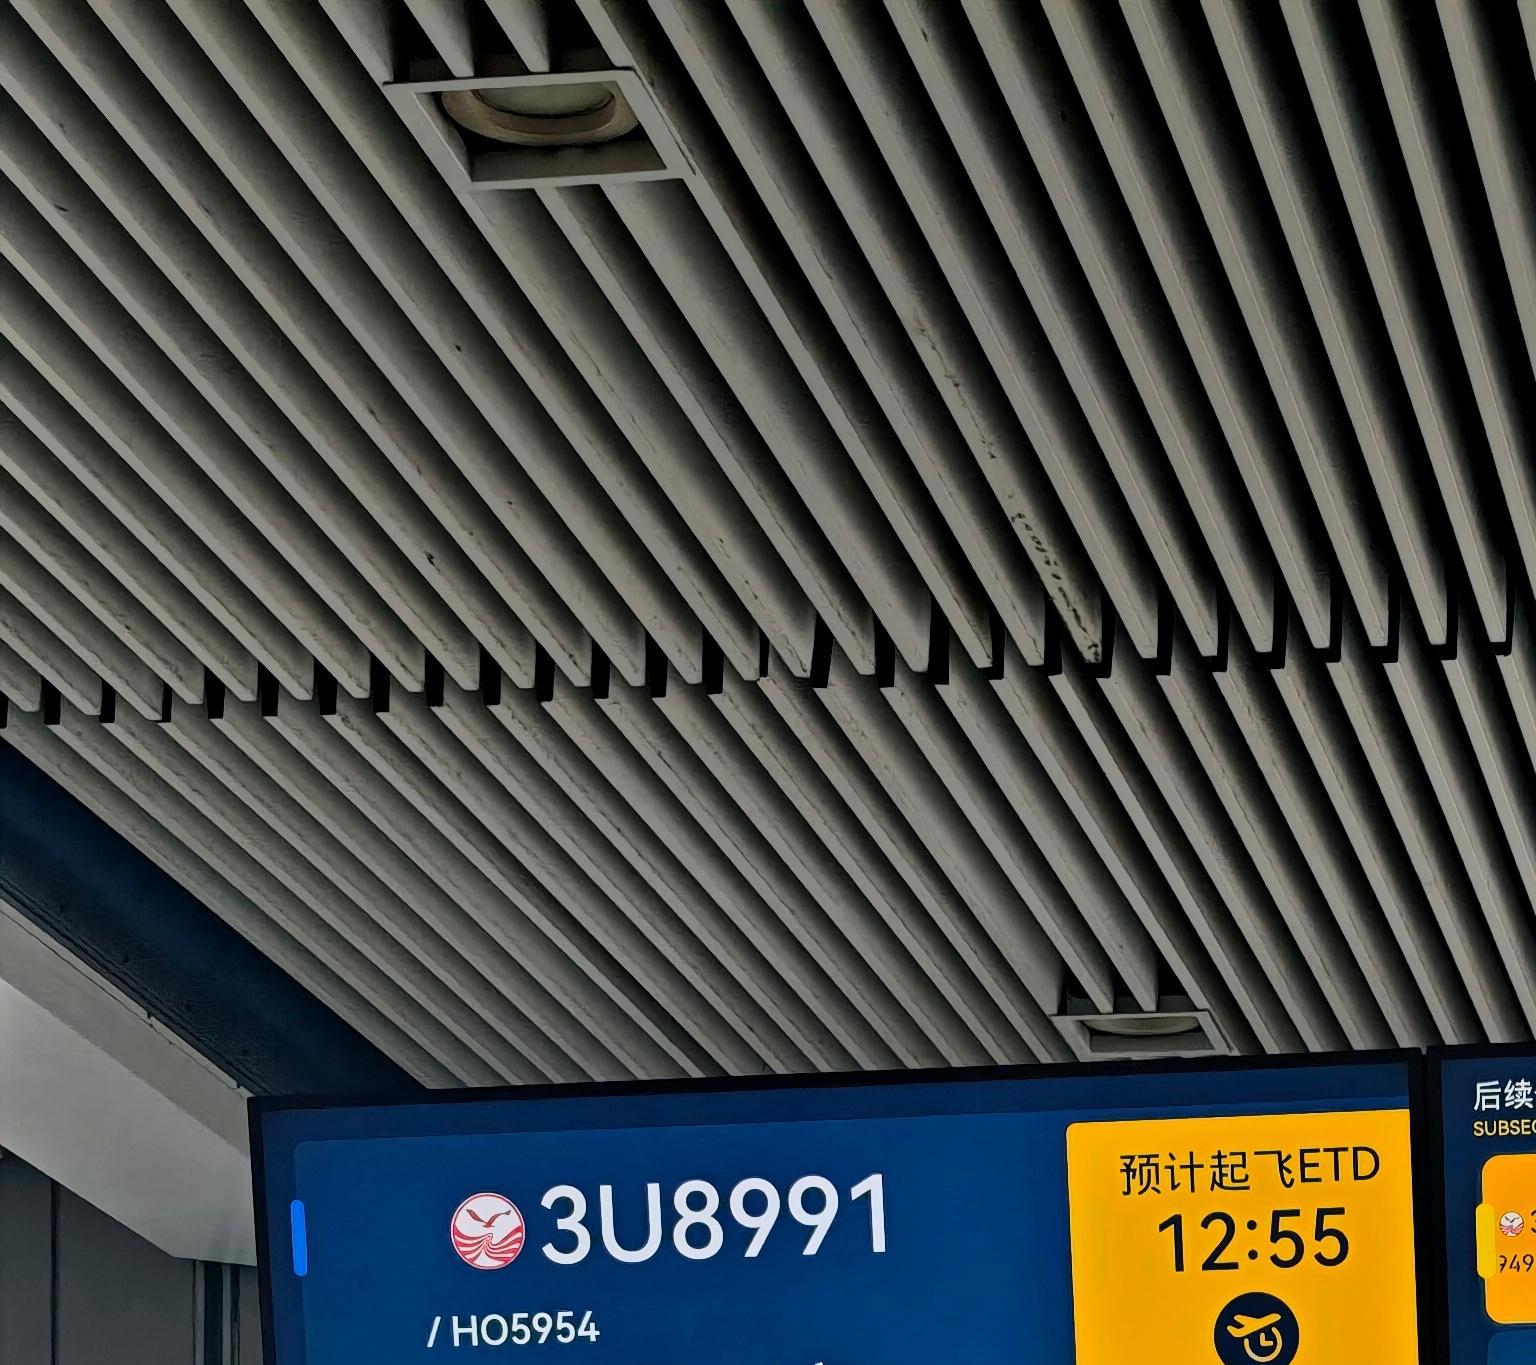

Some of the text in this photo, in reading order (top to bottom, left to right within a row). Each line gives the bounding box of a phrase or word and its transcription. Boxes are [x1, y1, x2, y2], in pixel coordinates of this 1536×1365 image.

[1119, 1146, 1380, 1196] 预计起飞ETD
[540, 1173, 886, 1265] 3U8991
[1158, 1206, 1349, 1273] 12:55
[452, 1310, 601, 1347] HO5954
